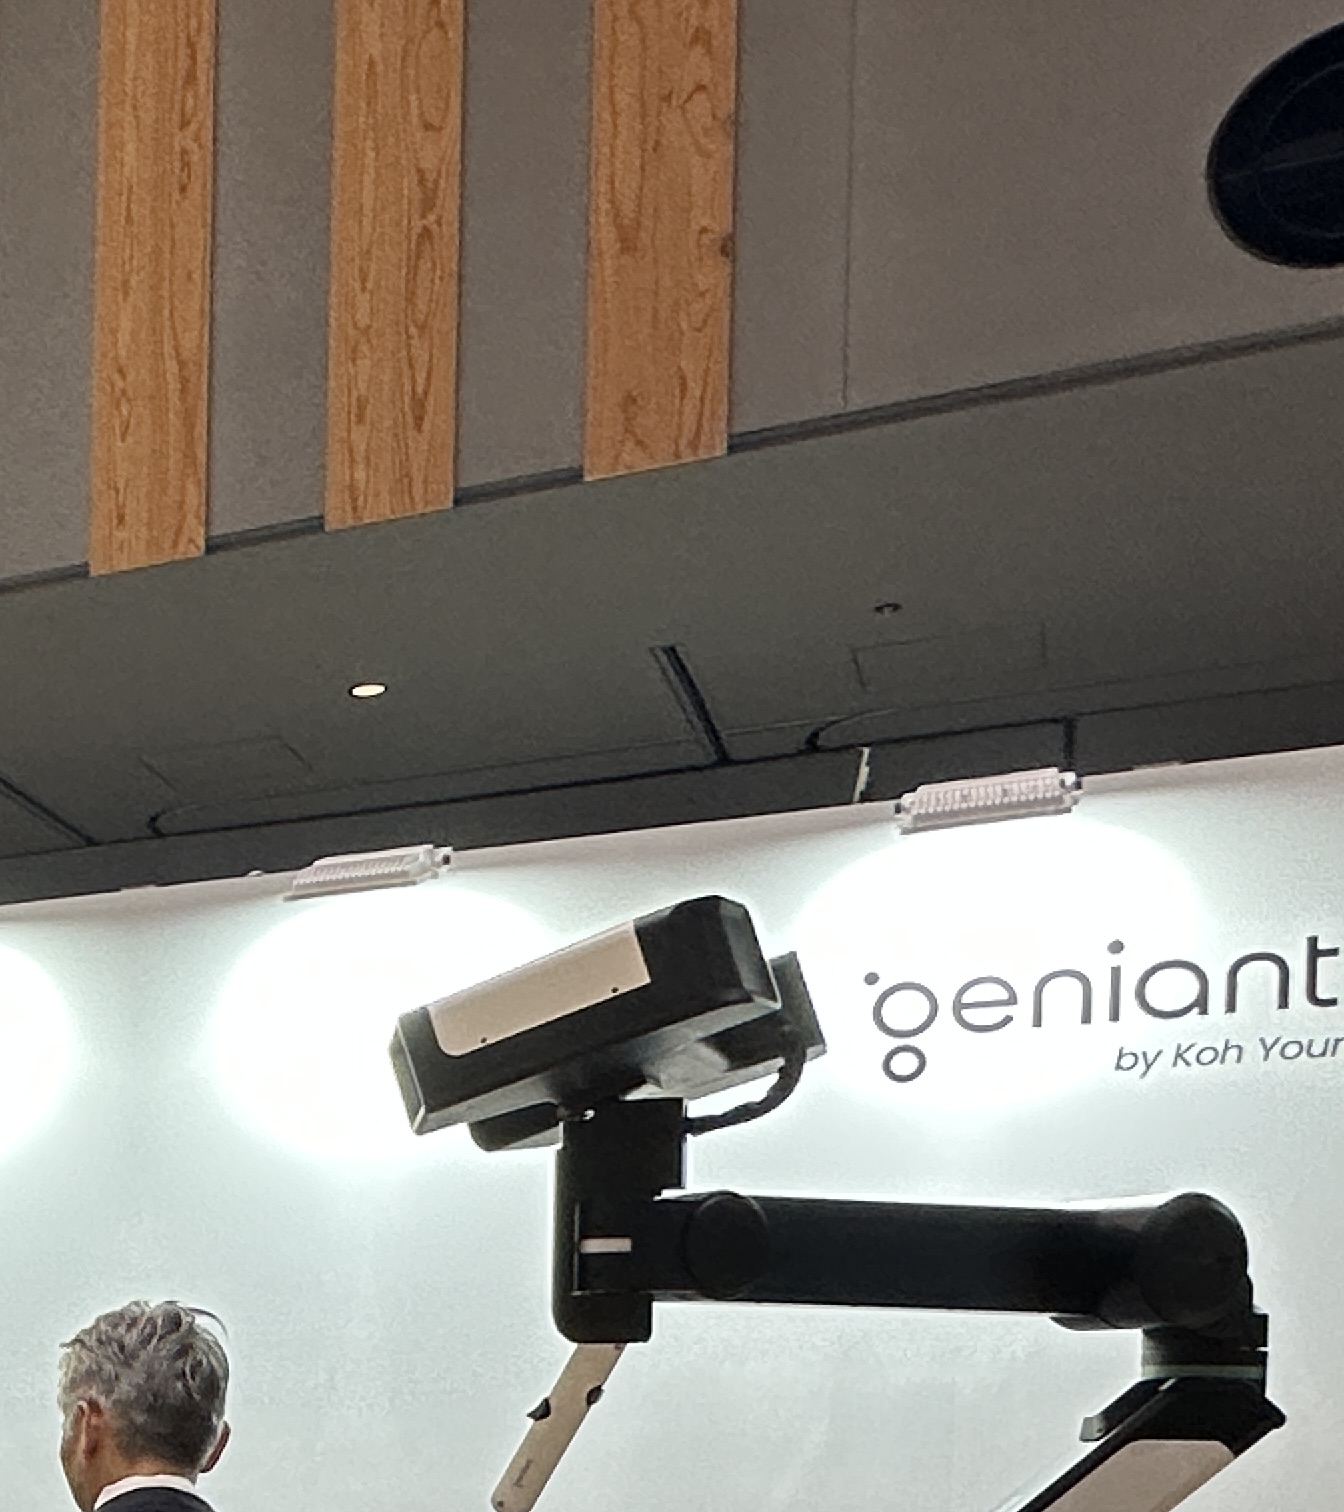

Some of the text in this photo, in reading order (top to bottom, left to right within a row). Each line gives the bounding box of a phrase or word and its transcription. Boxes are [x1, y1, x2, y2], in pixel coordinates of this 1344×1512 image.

[864, 935, 1340, 1083] geniant
[1114, 1045, 1163, 1079] by
[1172, 1037, 1242, 1069] Koh
